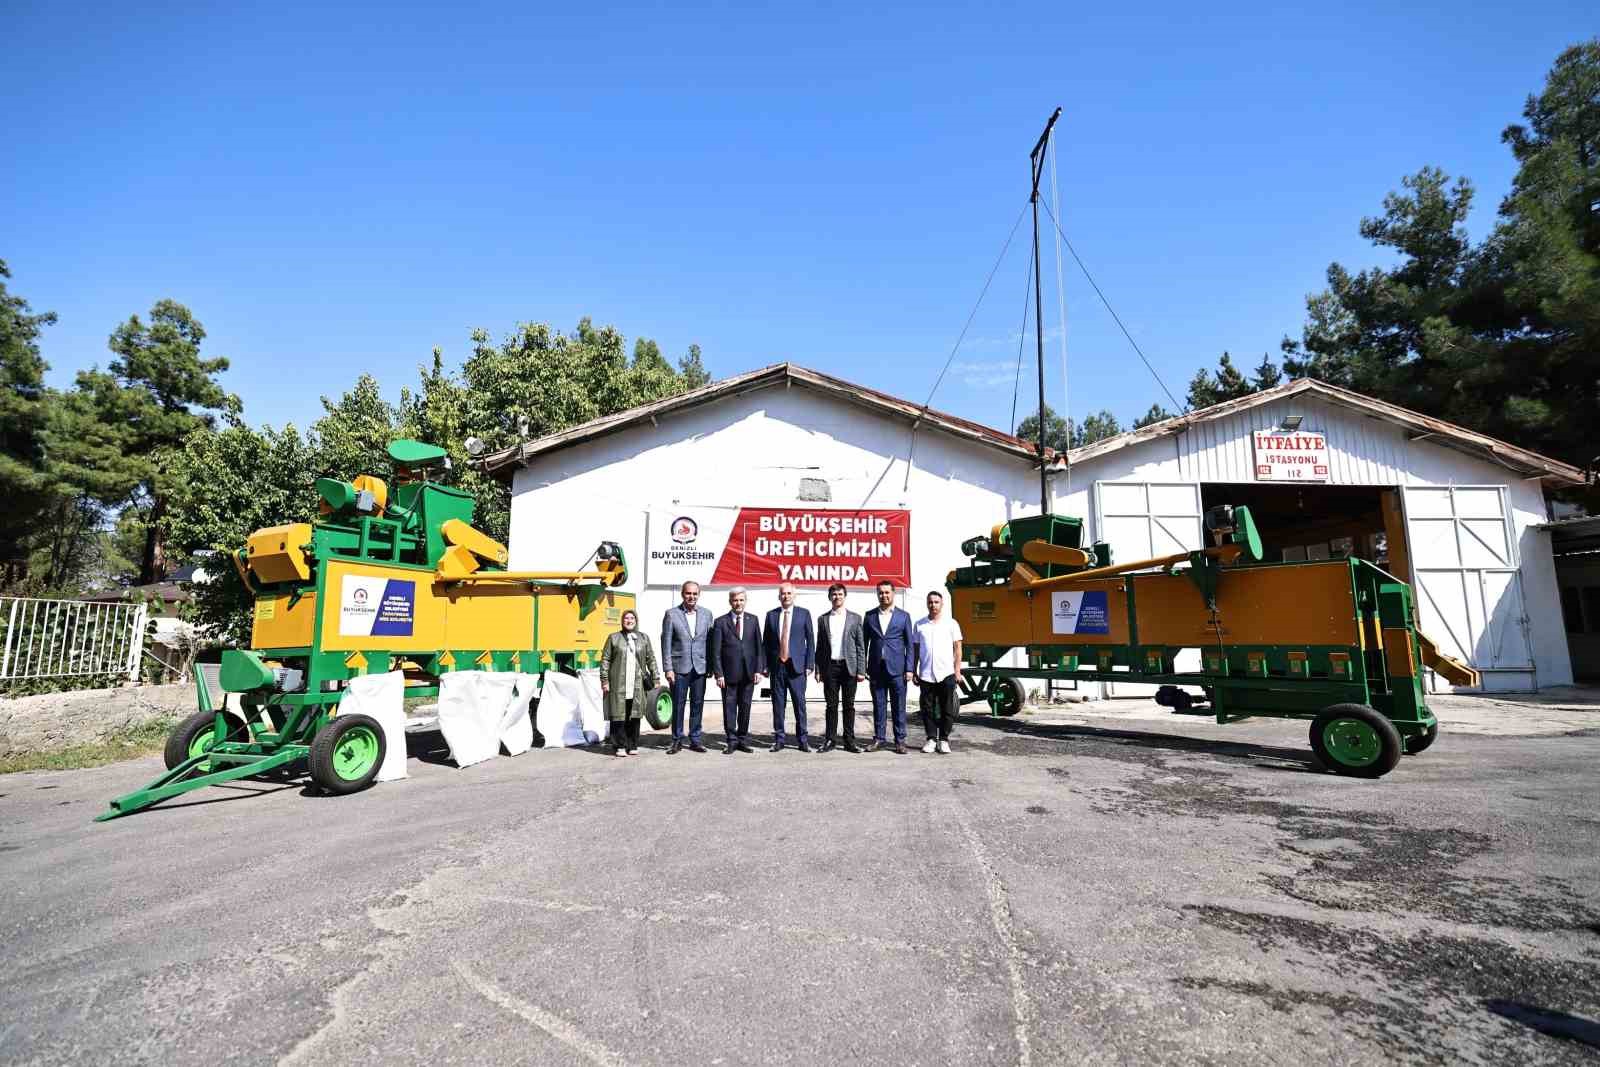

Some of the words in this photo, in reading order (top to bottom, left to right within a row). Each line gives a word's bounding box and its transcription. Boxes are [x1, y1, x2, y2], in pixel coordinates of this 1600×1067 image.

[1256, 432, 1324, 450] İTFAİYE
[759, 513, 888, 535] BÜYÜKŞEHİR
[755, 537, 891, 558] ÜRETİCİMİZİN
[778, 564, 869, 581] YANINDA
